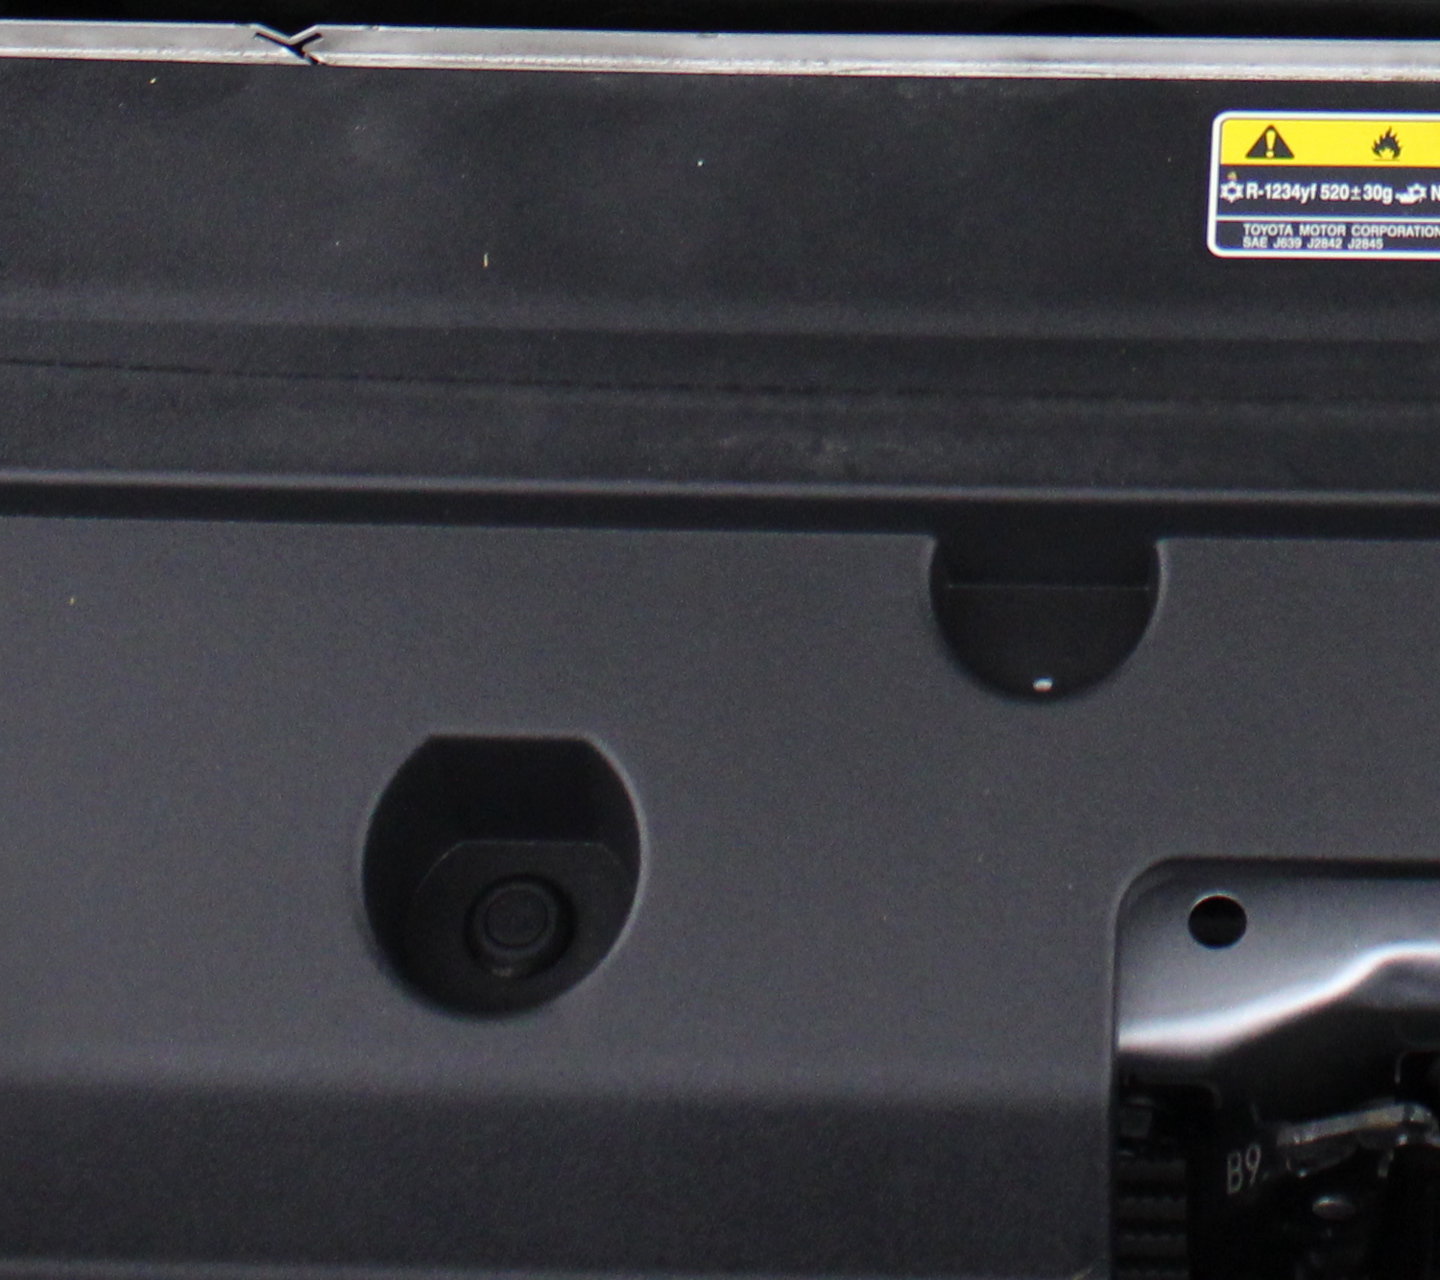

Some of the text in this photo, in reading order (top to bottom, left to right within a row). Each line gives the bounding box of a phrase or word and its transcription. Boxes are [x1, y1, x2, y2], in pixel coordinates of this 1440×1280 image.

[1245, 182, 1317, 204] R-1234yf
[1320, 183, 1393, 205] 520±30g
[1243, 223, 1293, 237] TOYOTA
[1298, 224, 1346, 237] MOTOR
[1242, 237, 1268, 249] SAE
[1226, 1143, 1263, 1195] B9
